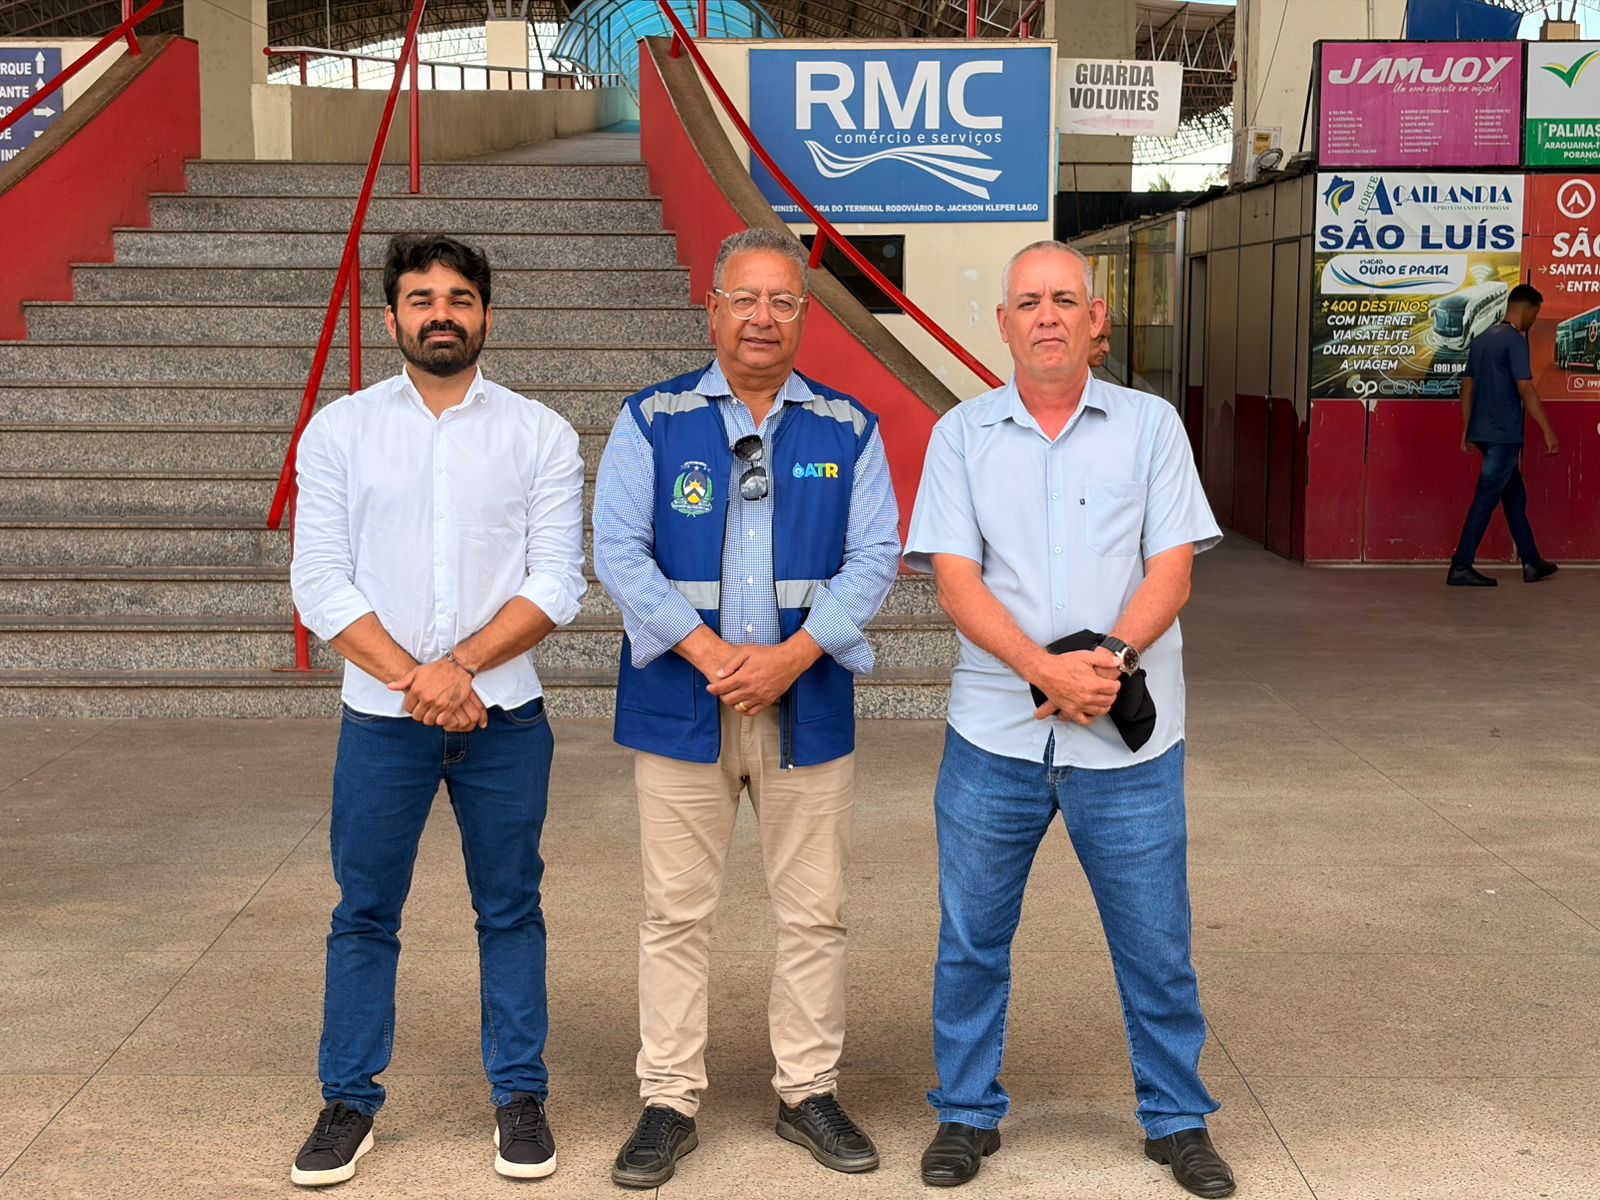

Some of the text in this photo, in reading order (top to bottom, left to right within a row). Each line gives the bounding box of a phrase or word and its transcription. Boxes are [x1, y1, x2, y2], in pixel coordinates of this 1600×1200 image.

[1075, 63, 1155, 87] GUARDA
[1328, 56, 1513, 85] JAMJOY
[795, 60, 1004, 130] RMC
[1069, 87, 1159, 112] VOLUMES
[834, 131, 1002, 146] comércio e serviços
[1358, 175, 1379, 213] FORTE
[844, 204, 883, 212] TERMINAL
[885, 203, 933, 212] RODOVIÁRIO
[1017, 203, 1039, 211] LAGO
[1319, 218, 1515, 250] SÃO LUÍS
[1359, 265, 1449, 275] OURO E PRATA
[1549, 263, 1592, 275] SANTA
[1359, 300, 1429, 312] DESTINOS
[1327, 315, 1416, 326] COM INTERNET
[1332, 328, 1410, 340] VIA SATÉLITE
[1322, 345, 1416, 355] DURANTE TODA
[1340, 360, 1399, 370] A VIAGEM
[804, 463, 839, 478] ATR
